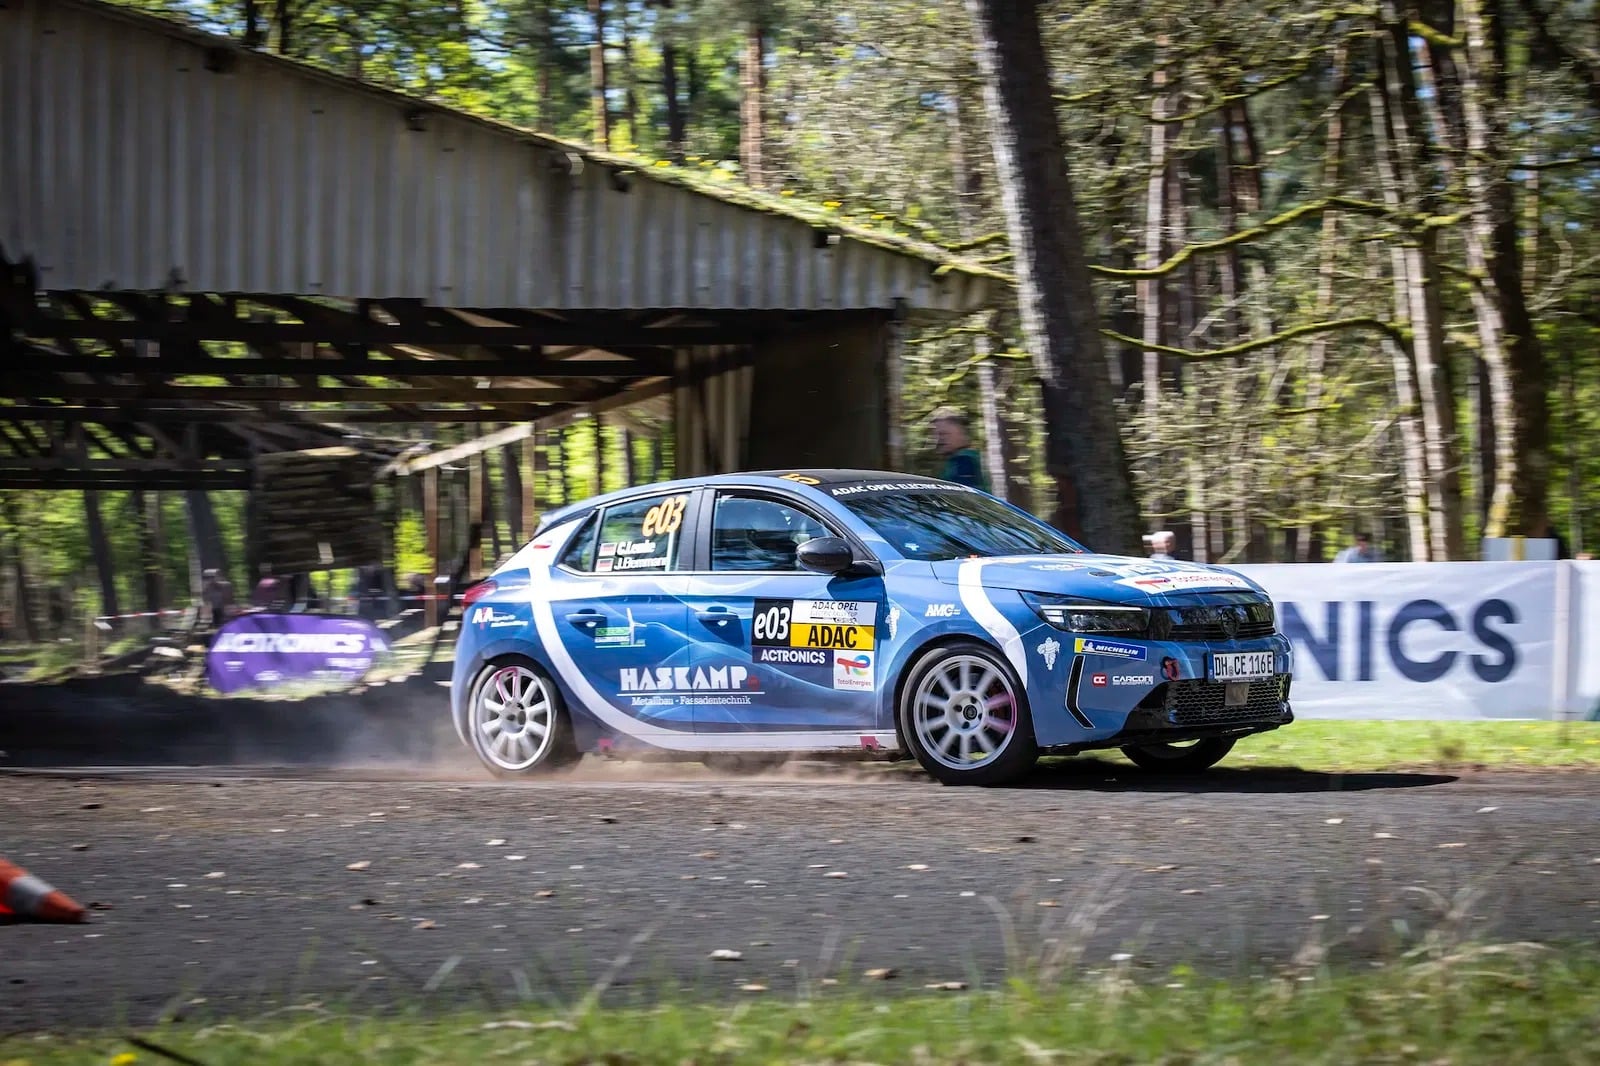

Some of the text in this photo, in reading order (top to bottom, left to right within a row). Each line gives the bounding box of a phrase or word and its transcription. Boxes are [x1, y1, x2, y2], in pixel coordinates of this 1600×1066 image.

[832, 485, 867, 496] ADAC
[642, 495, 687, 537] e03
[812, 601, 858, 611] ADAC OPEL
[754, 607, 790, 640] e03
[808, 625, 857, 648] ADAC
[761, 649, 825, 664] ACTRONICS
[1096, 645, 1138, 655] MICHELIN
[1215, 656, 1228, 676] DH
[1234, 655, 1247, 675] CE
[620, 665, 747, 691] HASKAMP
[837, 679, 871, 687] TotalEnergies
[631, 696, 673, 706] Metallbau
[680, 695, 751, 705] Fassadentechnik
